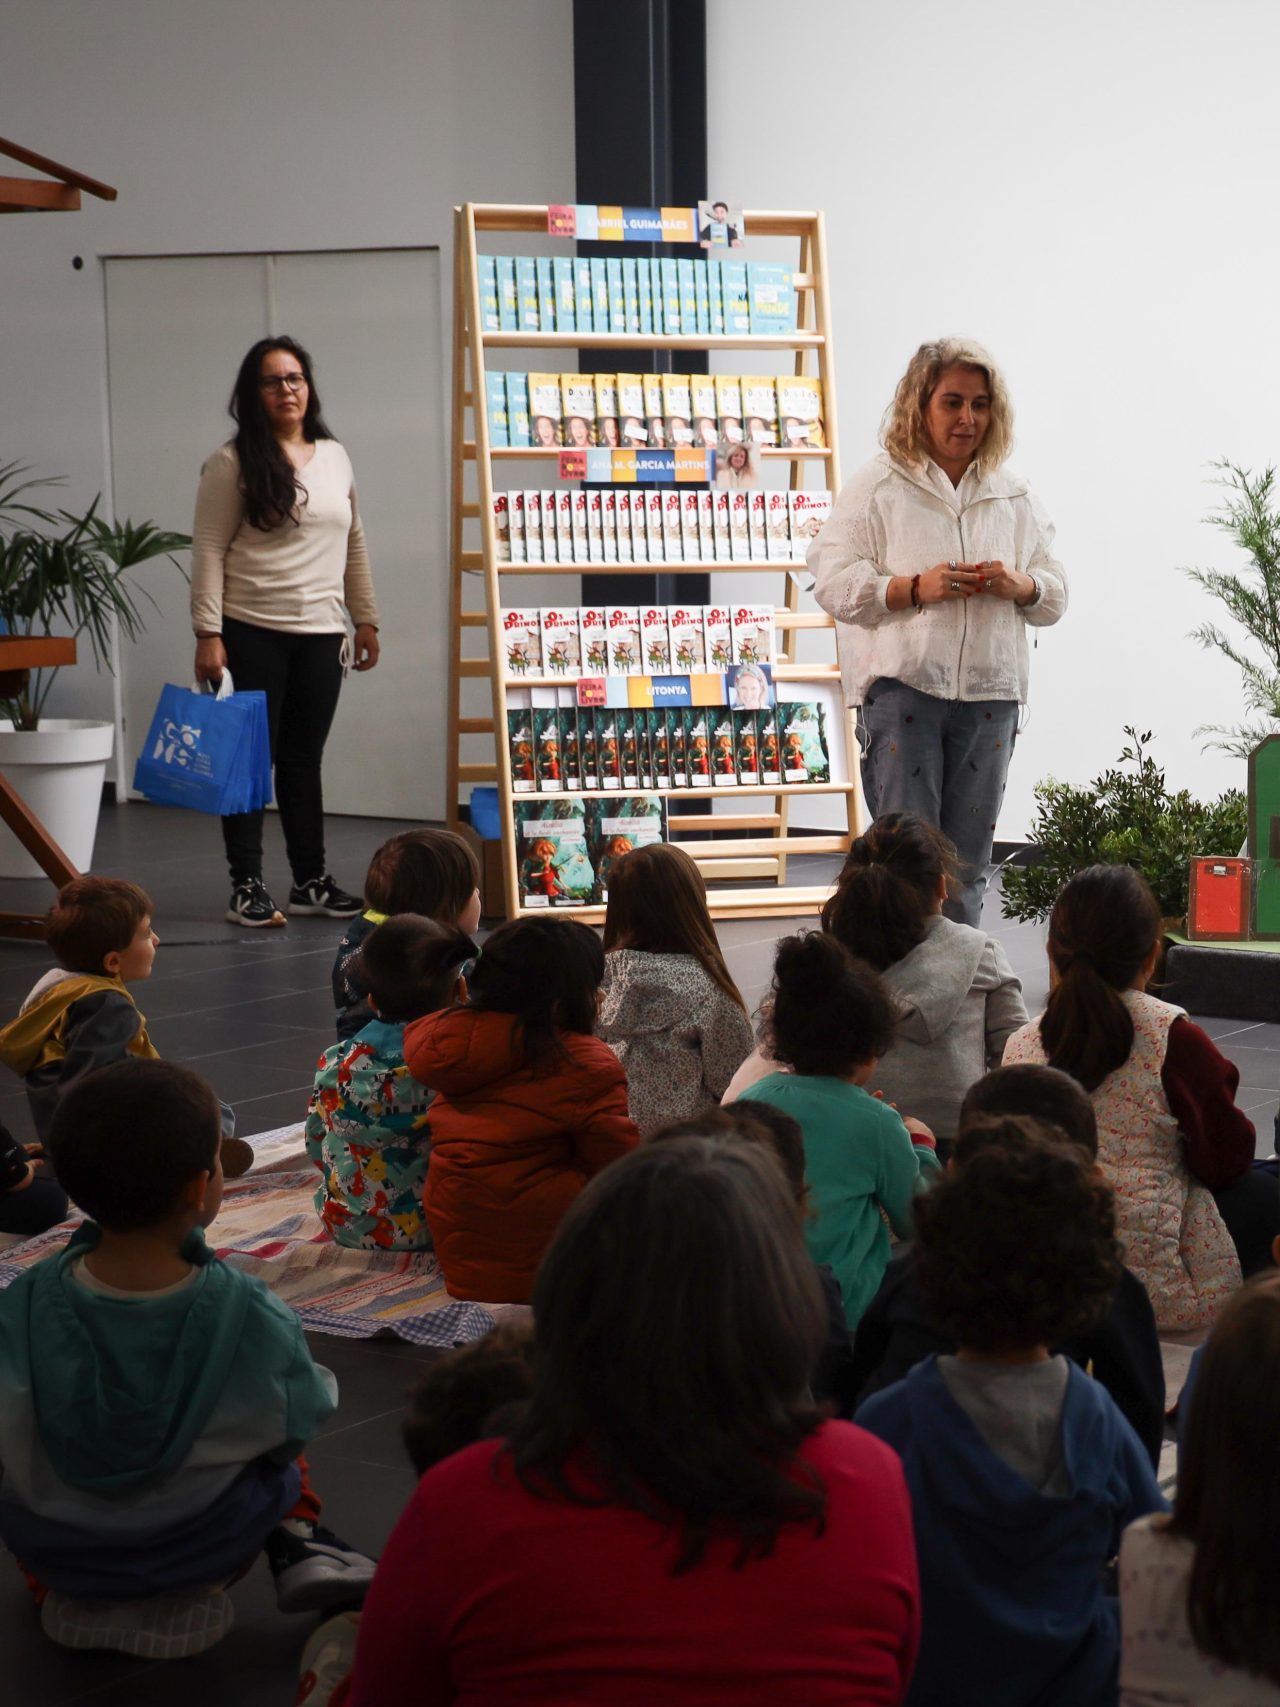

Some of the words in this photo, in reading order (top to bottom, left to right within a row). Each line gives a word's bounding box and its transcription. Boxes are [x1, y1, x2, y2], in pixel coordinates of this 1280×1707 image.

[591, 460, 612, 470] ANA
[614, 460, 626, 470] M.
[628, 460, 664, 470] GARCIA
[666, 460, 709, 470] MARTINS
[646, 686, 688, 695] LITONYA
